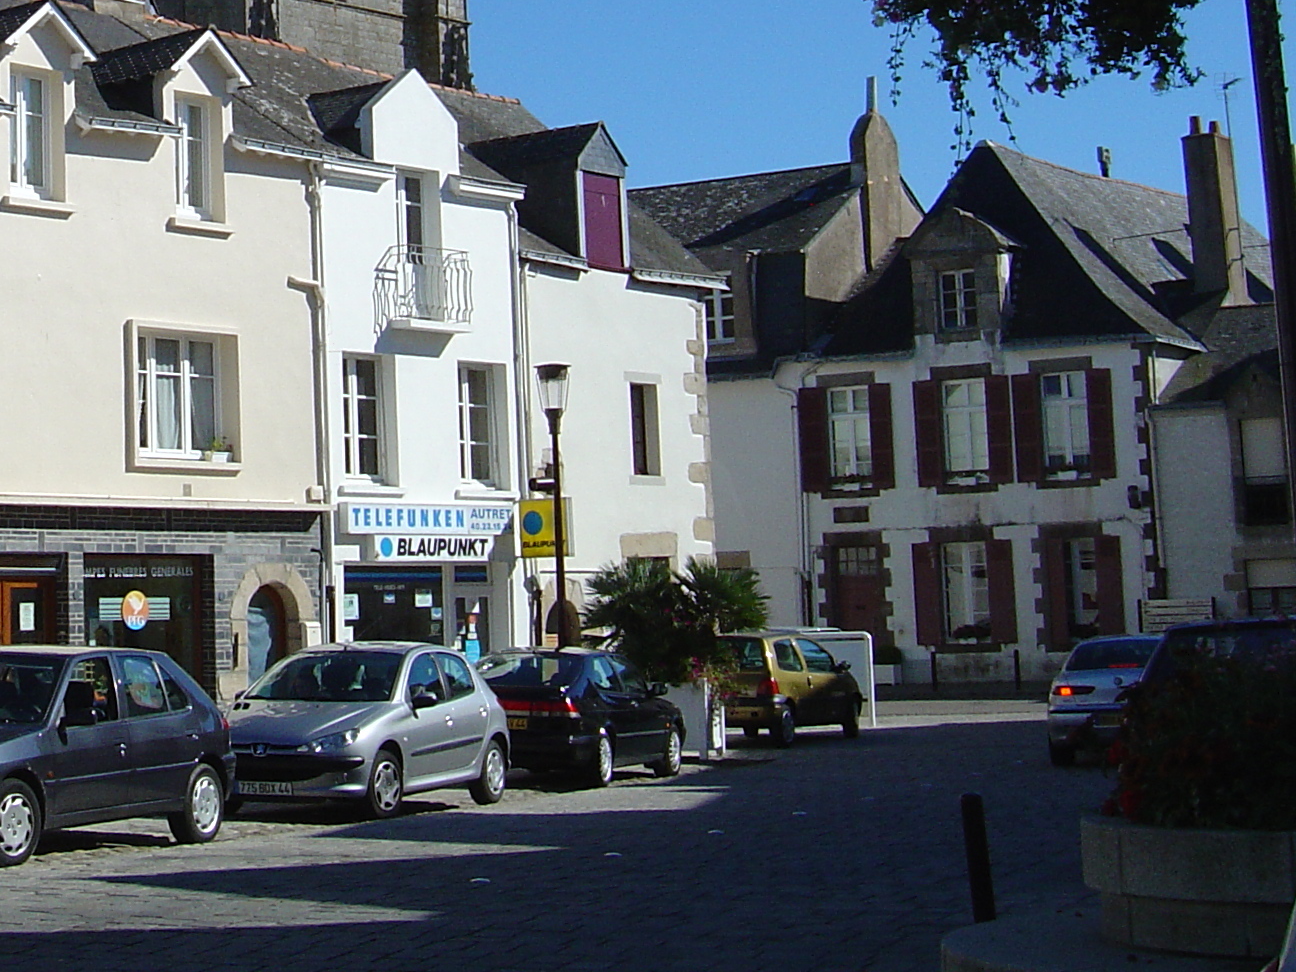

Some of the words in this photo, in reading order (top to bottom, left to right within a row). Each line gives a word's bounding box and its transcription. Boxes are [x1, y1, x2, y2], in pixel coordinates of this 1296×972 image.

[352, 508, 464, 528] TELEFUNKEN
[470, 508, 512, 520] AUTRET
[397, 538, 488, 557] BLAUPUNKT
[127, 616, 145, 626] PFG
